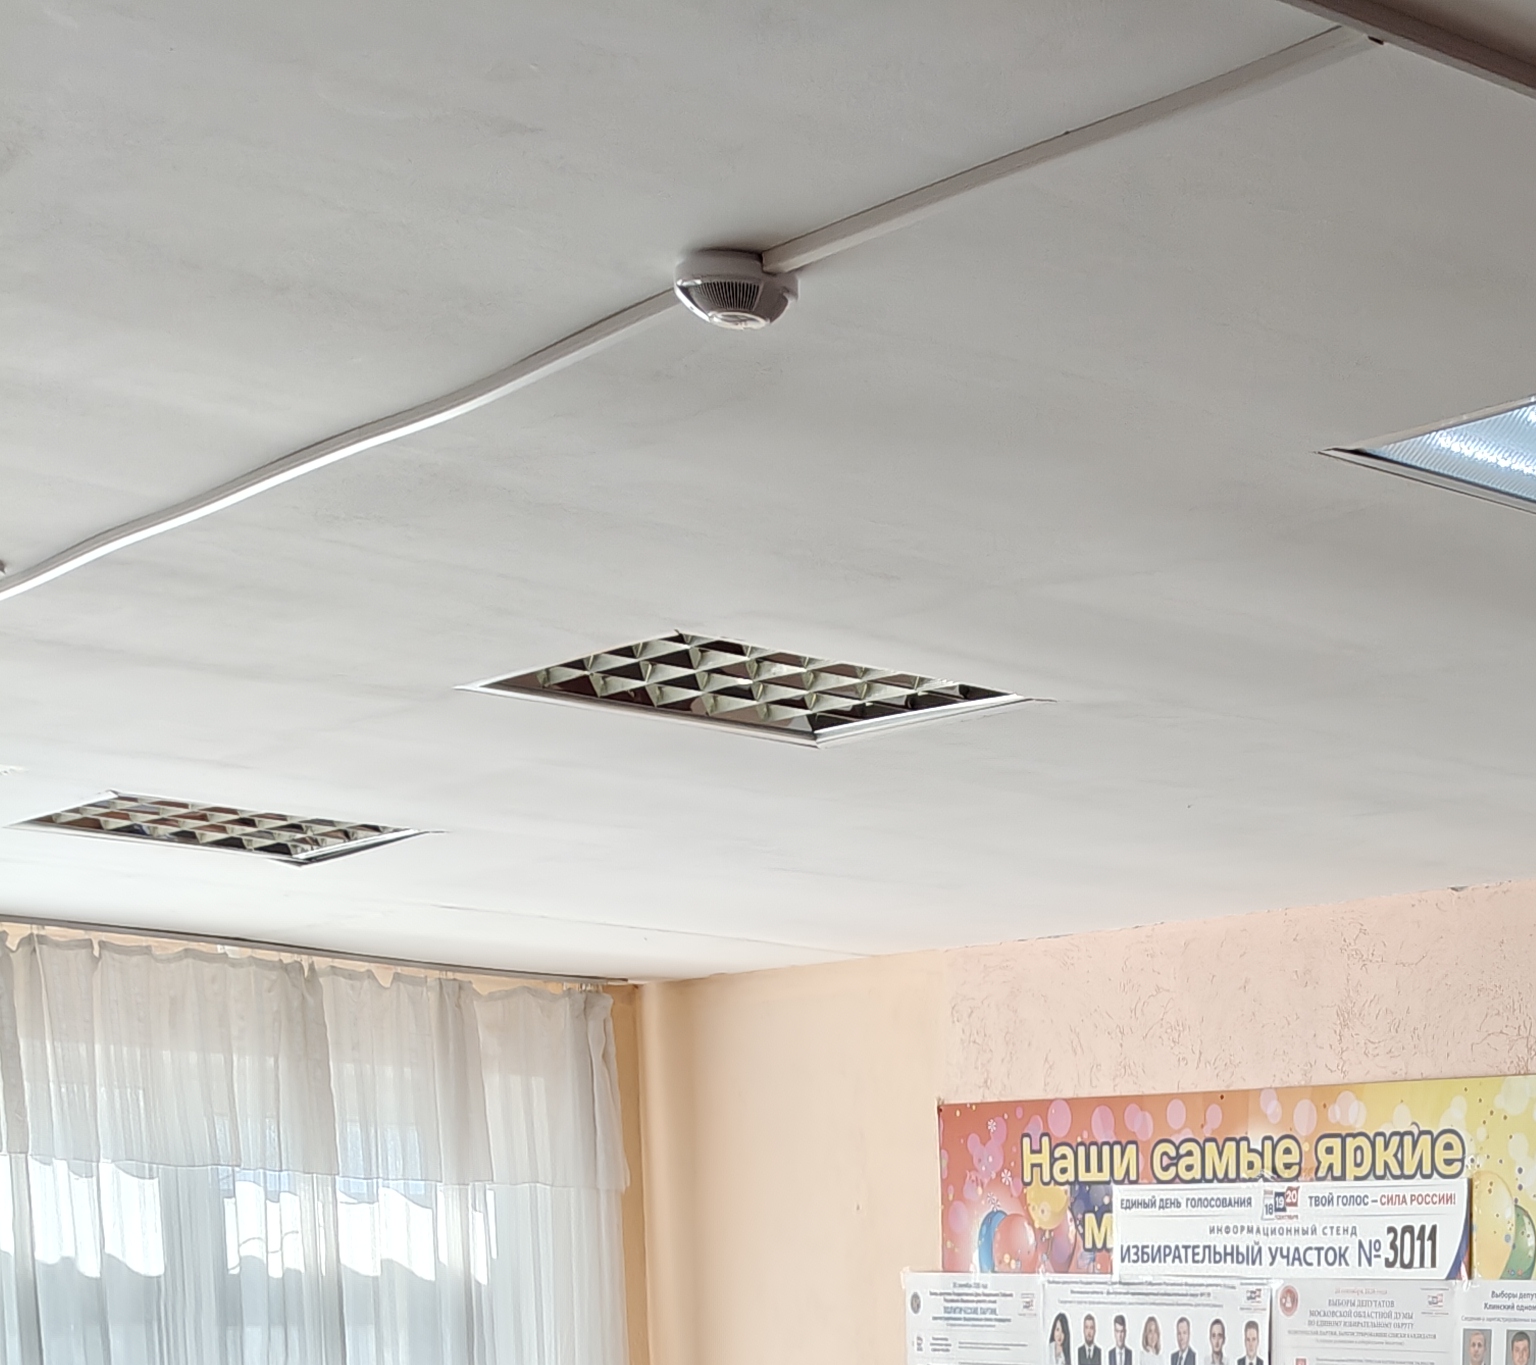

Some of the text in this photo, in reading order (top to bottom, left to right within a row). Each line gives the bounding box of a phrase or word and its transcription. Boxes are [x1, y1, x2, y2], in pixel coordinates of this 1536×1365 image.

[1021, 1128, 1466, 1186] Наши самые яркие
[1275, 1196, 1285, 1208] 19
[1286, 1190, 1298, 1202] 20
[1308, 1192, 1335, 1207] ТВОЙ
[1336, 1194, 1369, 1207] ГОЛОС
[1380, 1194, 1408, 1206] СИЛА
[1410, 1193, 1456, 1206] РОССИИ!
[1120, 1195, 1252, 1210] ЕДИНЫЙ ДЕНЬ ГОЛОСОВАНИЯ
[1264, 1203, 1273, 1215] 18
[1208, 1224, 1358, 1237] ИНФОРМАЦИОННЫЙ СТЕНД
[1120, 1224, 1438, 1269] ИЗБИРАТЕЛЬНЫЙ УЧАСТОК № 3011
[1491, 1290, 1518, 1300] Выборы
[1484, 1302, 1515, 1311] Клинский
